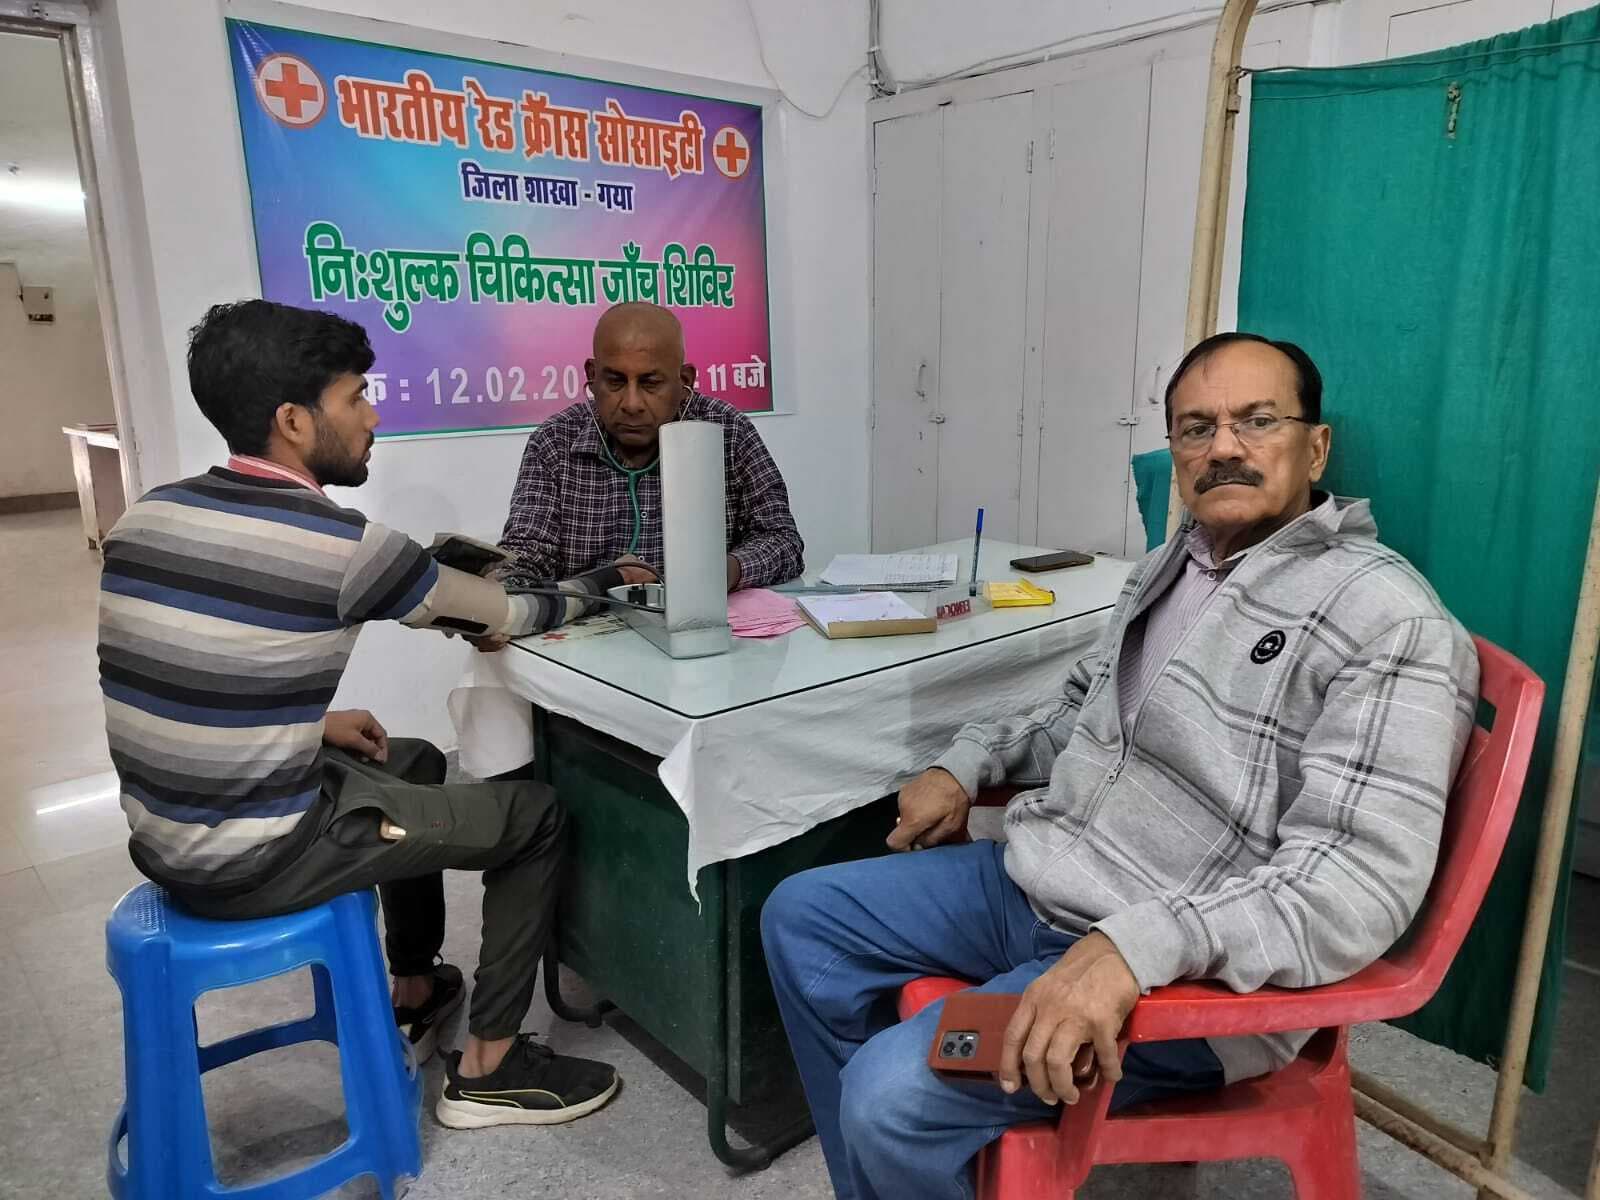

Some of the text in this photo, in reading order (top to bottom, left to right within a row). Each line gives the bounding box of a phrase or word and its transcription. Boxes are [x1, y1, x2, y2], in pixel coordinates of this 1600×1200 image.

[336, 70, 468, 147] भारतीय
[464, 77, 515, 150] रेड
[593, 98, 704, 179] सोसाइटी
[460, 160, 519, 202] जिला
[523, 175, 579, 207] शाखा
[596, 182, 634, 211] गया
[464, 231, 597, 306] चिकित्सा
[598, 240, 660, 305] जाँच
[663, 243, 735, 307] शिविर
[426, 365, 595, 405] 12.02.20
[706, 363, 727, 392] 11
[731, 354, 767, 389] बजे
